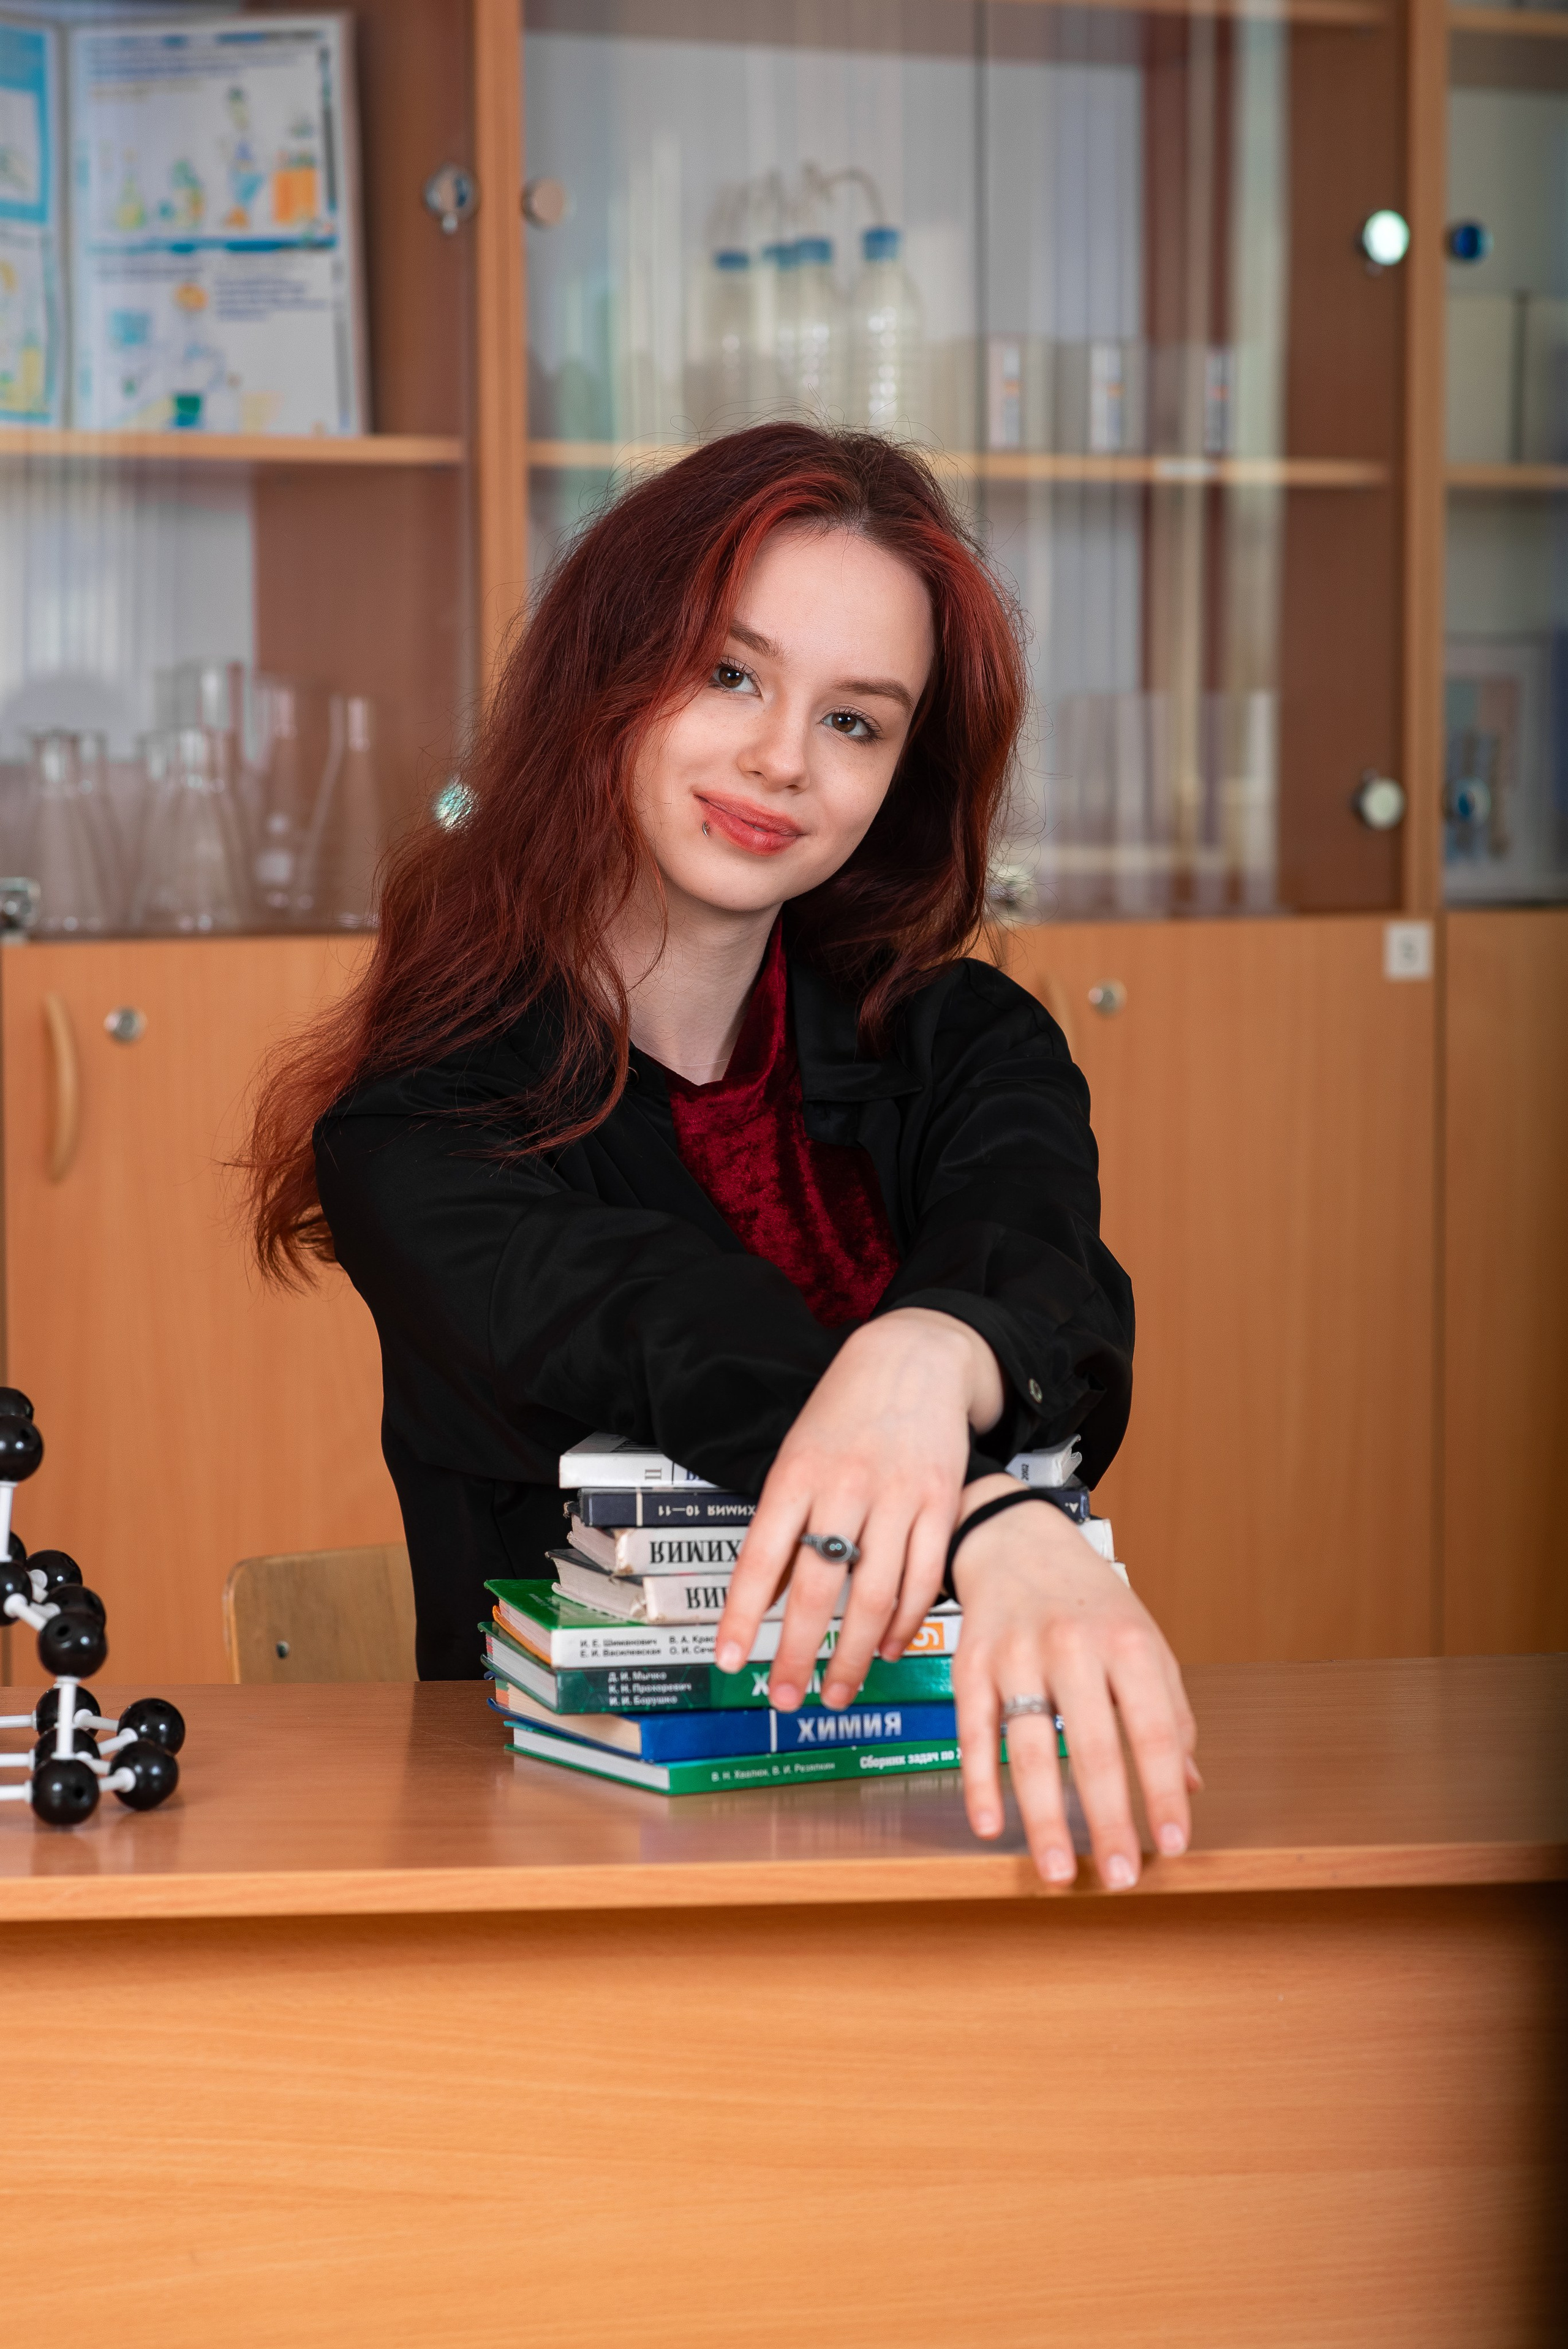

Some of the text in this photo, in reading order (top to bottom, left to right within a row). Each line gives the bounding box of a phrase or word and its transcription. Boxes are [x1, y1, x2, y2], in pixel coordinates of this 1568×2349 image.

[707, 1504, 756, 1517] ХИМИЯ
[649, 1539, 742, 1564] ХИМИЯ
[685, 1586, 728, 1610] ИЯ
[579, 1637, 658, 1648] И. Е. Шиманович
[668, 1635, 717, 1645] В. А. Крас
[579, 1648, 662, 1658] Е. И. Василевская
[669, 1646, 679, 1655] О.
[681, 1646, 690, 1654] И.
[608, 1670, 668, 1683] Д. И. Мычко
[632, 1683, 692, 1694] Прохоревич
[633, 1695, 678, 1707] Борушко
[797, 1711, 902, 1744] ХИМИЯ
[859, 1754, 906, 1770] Сборник
[907, 1750, 939, 1765] задач
[940, 1749, 955, 1761] по
